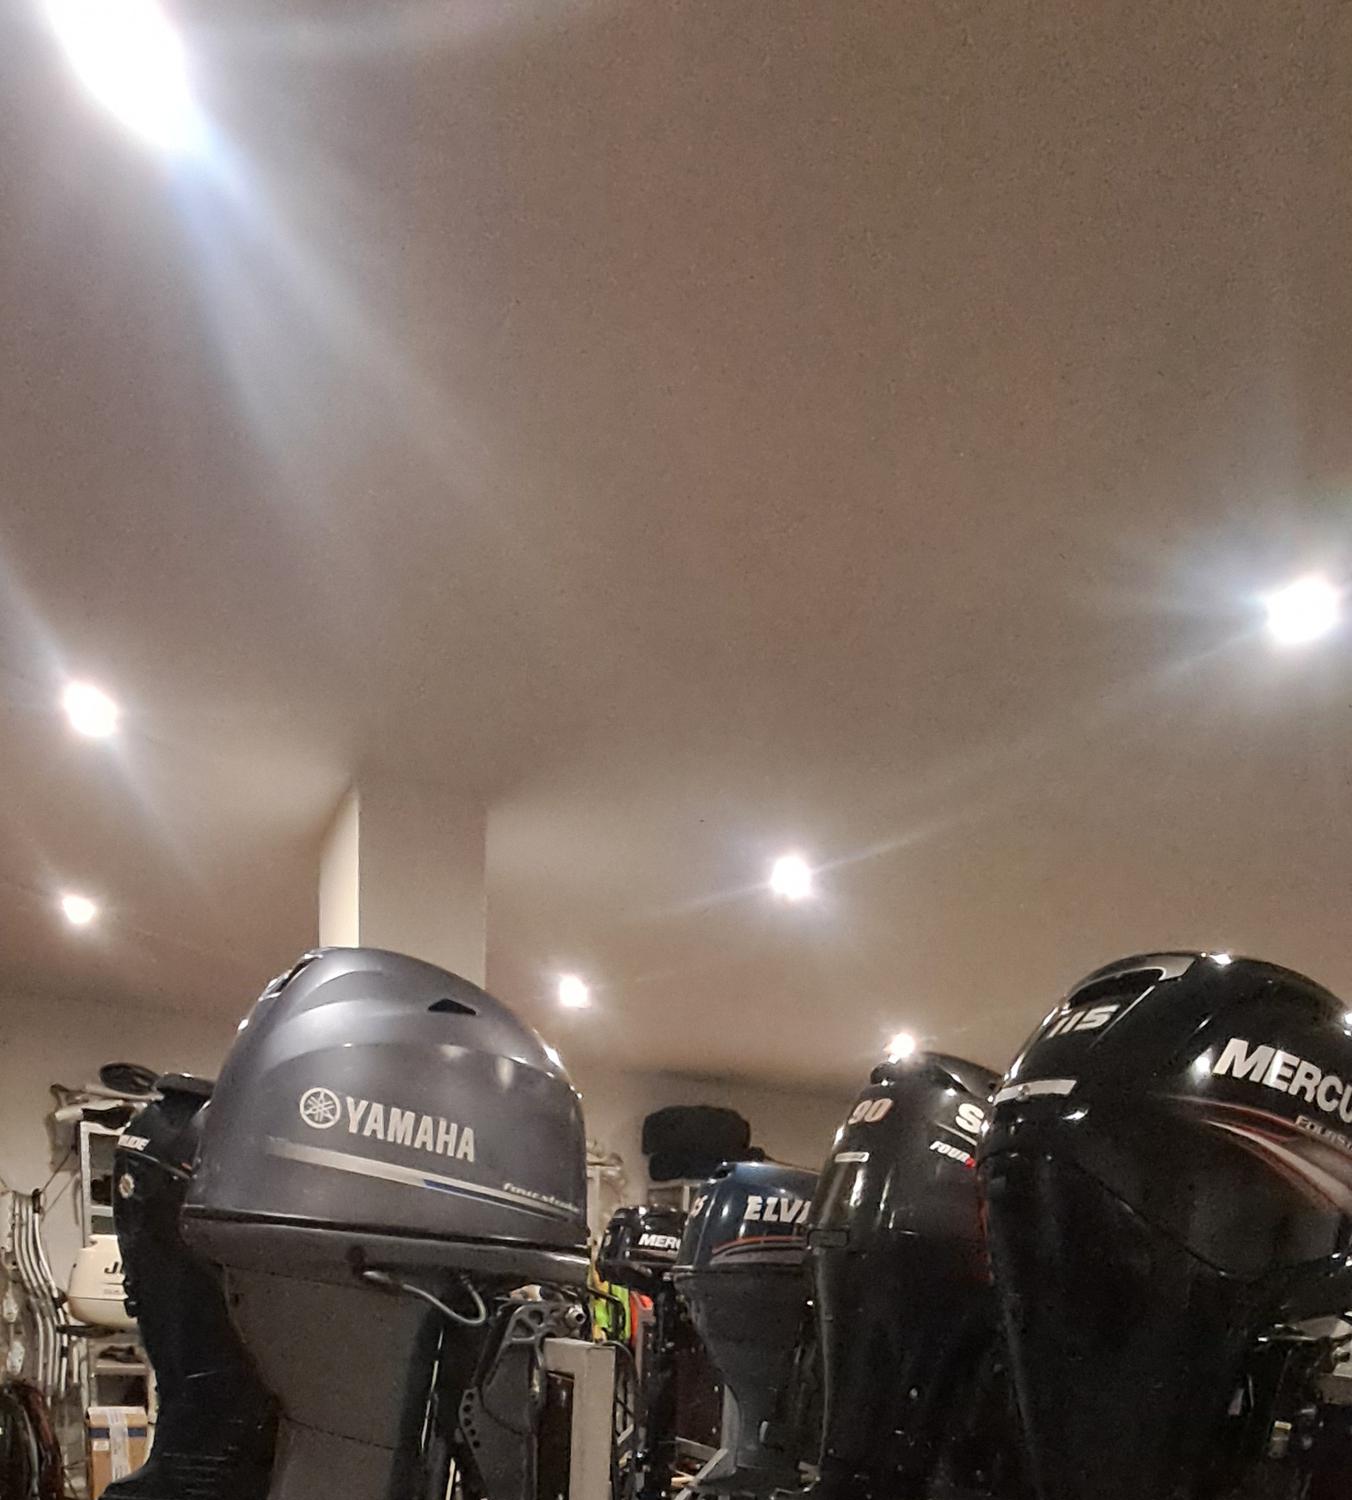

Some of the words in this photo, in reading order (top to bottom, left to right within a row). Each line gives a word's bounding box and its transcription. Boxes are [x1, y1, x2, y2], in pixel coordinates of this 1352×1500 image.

[1047, 1004, 1120, 1039] 115
[848, 1098, 894, 1125] 90
[346, 1096, 476, 1163] YAMAHA
